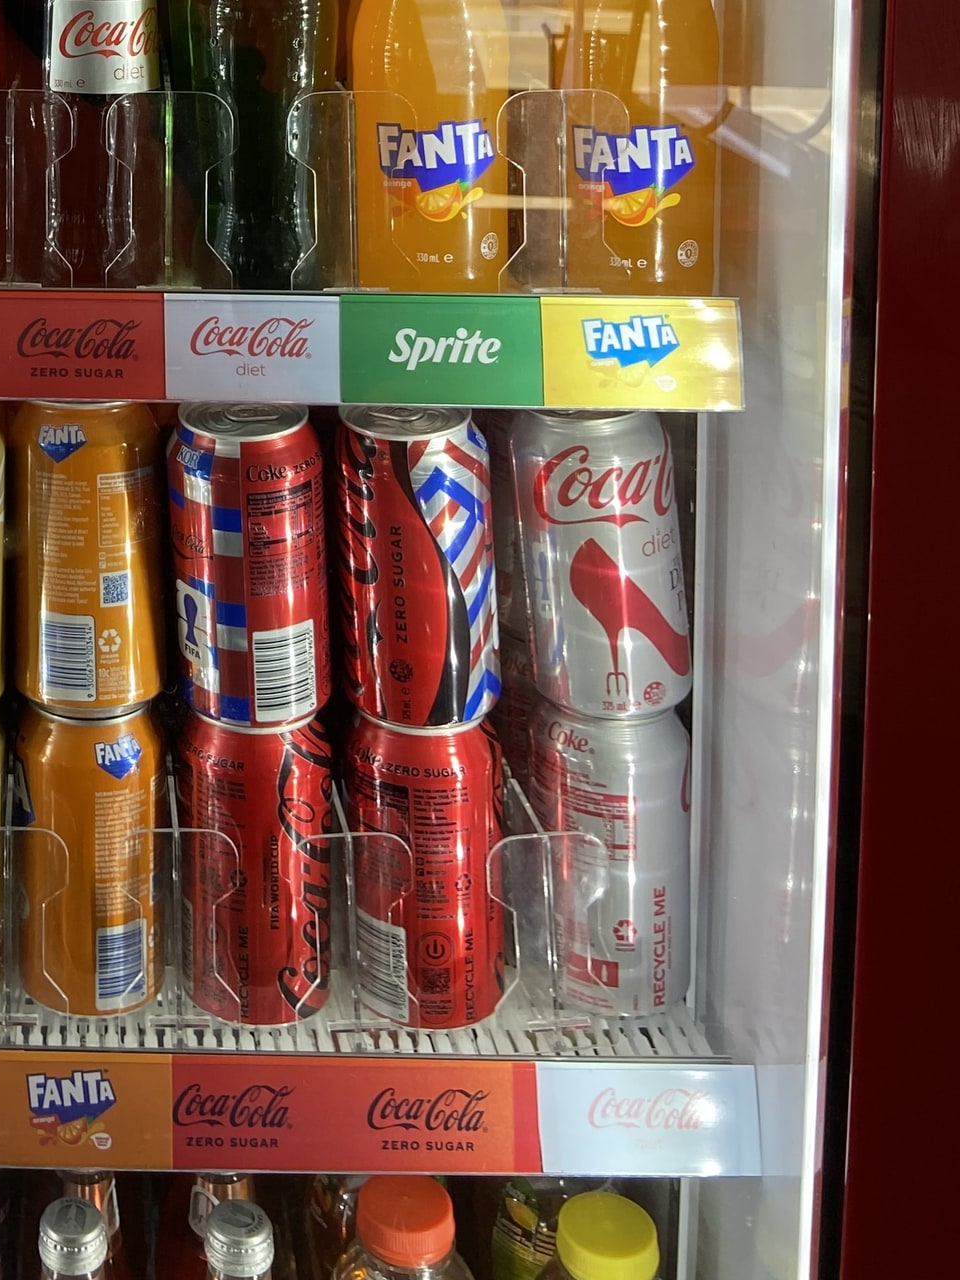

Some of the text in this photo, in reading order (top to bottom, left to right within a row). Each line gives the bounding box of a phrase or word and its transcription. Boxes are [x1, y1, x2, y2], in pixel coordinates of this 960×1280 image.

[113, 63, 145, 80] diet
[378, 122, 492, 169] FANTA
[573, 125, 694, 174] FANTA
[416, 252, 428, 262] 330
[429, 253, 440, 263] mL
[17, 317, 142, 360] Coca-Cola
[190, 316, 315, 359] Coca-Cola
[387, 327, 502, 371] Sprite
[583, 317, 678, 353] FANTA
[30, 367, 124, 379] ZERO SUGAR
[235, 362, 266, 378] diet
[38, 424, 86, 445] FANTA
[176, 445, 200, 469] KOR
[247, 457, 316, 482] Coke ZERO
[642, 528, 677, 558] diet
[390, 525, 408, 644] ZERO SUGAR
[184, 643, 200, 660] FIFA
[95, 736, 141, 765] FANTA
[548, 721, 589, 753] Coke
[206, 753, 245, 771] SUGAR
[386, 763, 420, 778] ZERO
[424, 766, 466, 778] SUGAR
[271, 835, 280, 930] FIFA WORLD CUP
[653, 885, 666, 1007] RECYCLE ME
[239, 926, 249, 1018] RECYCLE ME
[465, 928, 475, 1021] RECYCLE ME
[28, 1071, 113, 1109] FANTA
[173, 1084, 296, 1130] Coca-Cola
[367, 1087, 490, 1133] Coca-Cola
[588, 1087, 707, 1131] Coca-Cola
[186, 1137, 279, 1149] ZERO SUGAR
[381, 1140, 475, 1152] ZERO SUGAR
